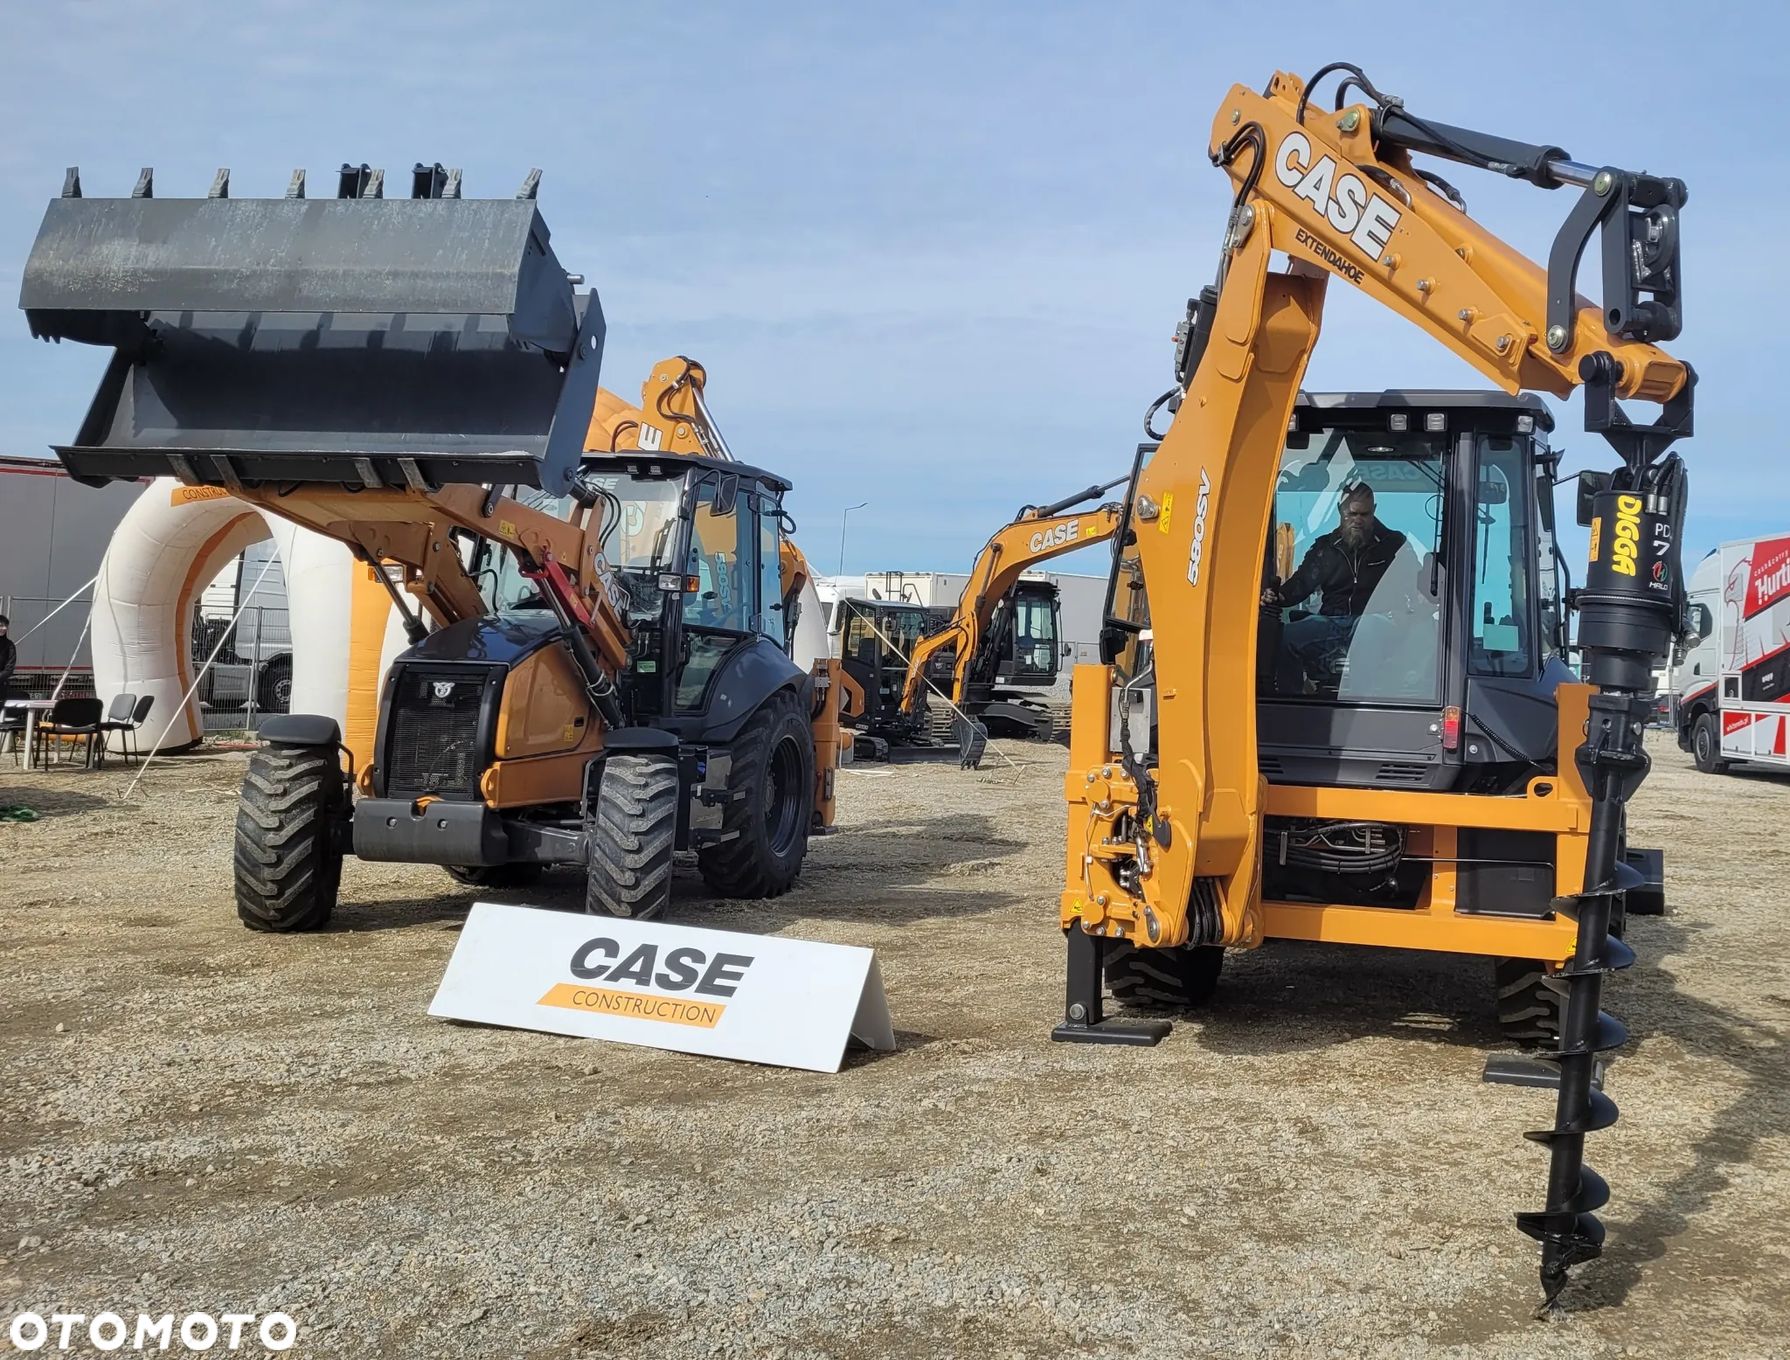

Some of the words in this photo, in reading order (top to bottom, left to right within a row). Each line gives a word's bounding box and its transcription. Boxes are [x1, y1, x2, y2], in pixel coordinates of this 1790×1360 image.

[1275, 131, 1402, 262] CASE
[1295, 228, 1365, 285] EXTENDAHOE
[1029, 519, 1080, 554] CASE
[1187, 466, 1211, 587] 580SV
[1612, 495, 1642, 577] DIGGA
[1653, 540, 1671, 556] 7
[570, 937, 755, 998] CASE
[572, 990, 716, 1024] CONSTRUCTION
